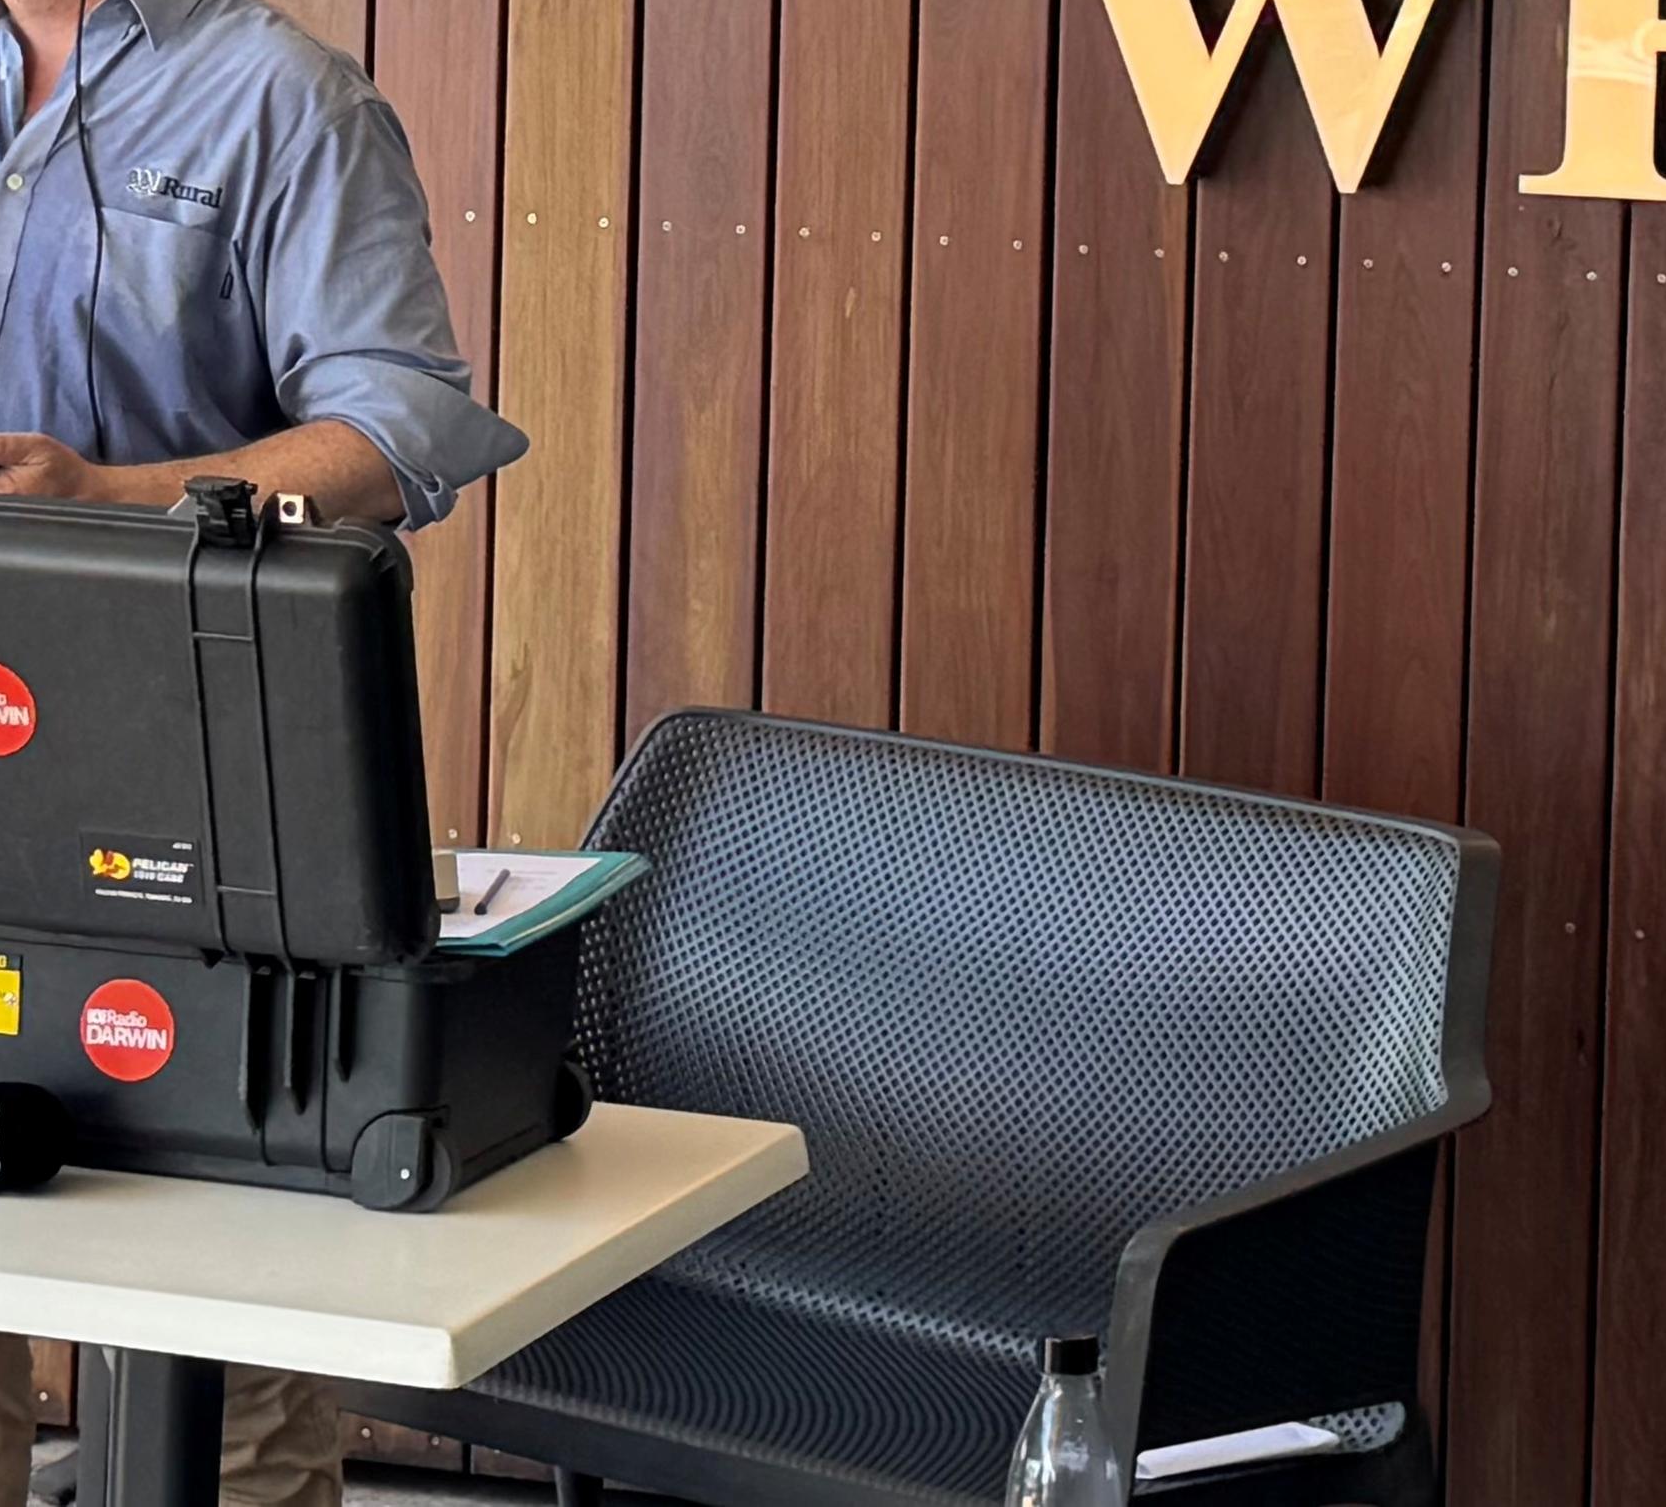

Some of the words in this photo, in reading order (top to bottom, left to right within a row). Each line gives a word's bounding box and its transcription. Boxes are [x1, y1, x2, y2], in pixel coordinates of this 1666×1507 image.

[160, 175, 223, 209] Rural
[132, 857, 189, 874] PELICAN
[107, 1009, 148, 1029] Radio
[86, 1025, 167, 1051] DARWIN
